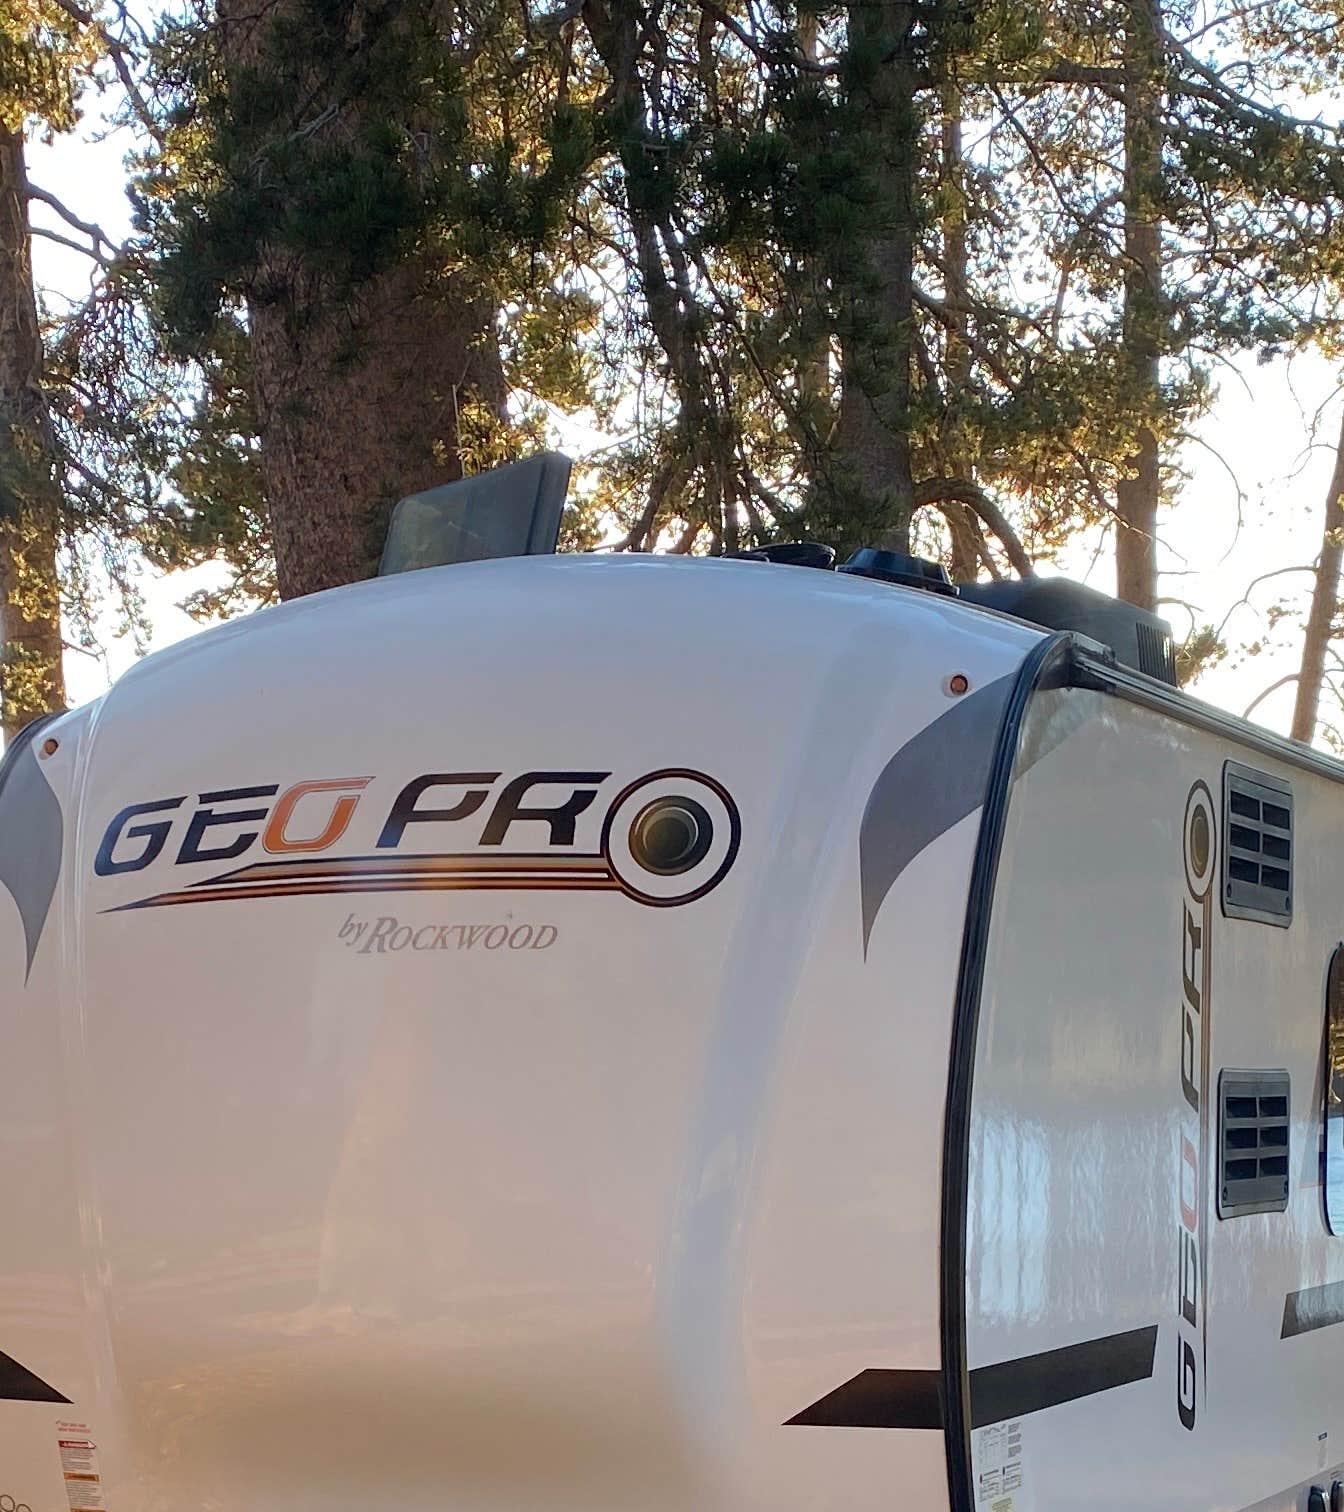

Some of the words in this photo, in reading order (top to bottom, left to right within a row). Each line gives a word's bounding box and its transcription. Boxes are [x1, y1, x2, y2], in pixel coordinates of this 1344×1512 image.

[93, 776, 376, 877] GEO
[375, 767, 742, 908] PRO
[338, 913, 368, 947] by
[357, 916, 558, 954] ROCKWOOD
[1181, 778, 1216, 1114] PRO
[1177, 1120, 1200, 1432] GEO
